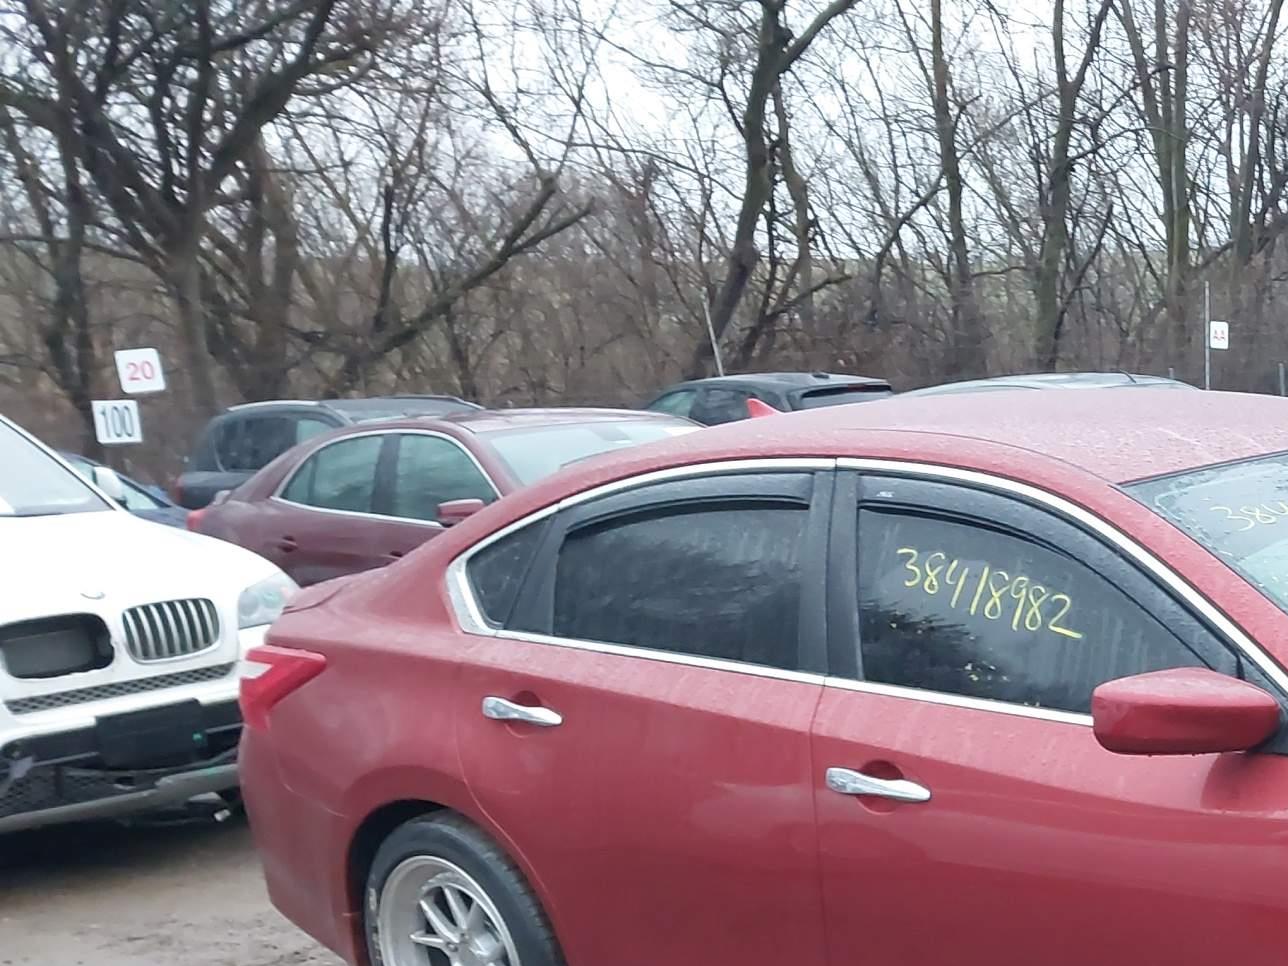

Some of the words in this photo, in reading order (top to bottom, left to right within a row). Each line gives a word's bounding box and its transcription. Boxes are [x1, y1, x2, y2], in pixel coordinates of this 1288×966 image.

[126, 360, 155, 381] 20
[100, 405, 135, 438] 100
[896, 547, 1084, 639] 38418982
